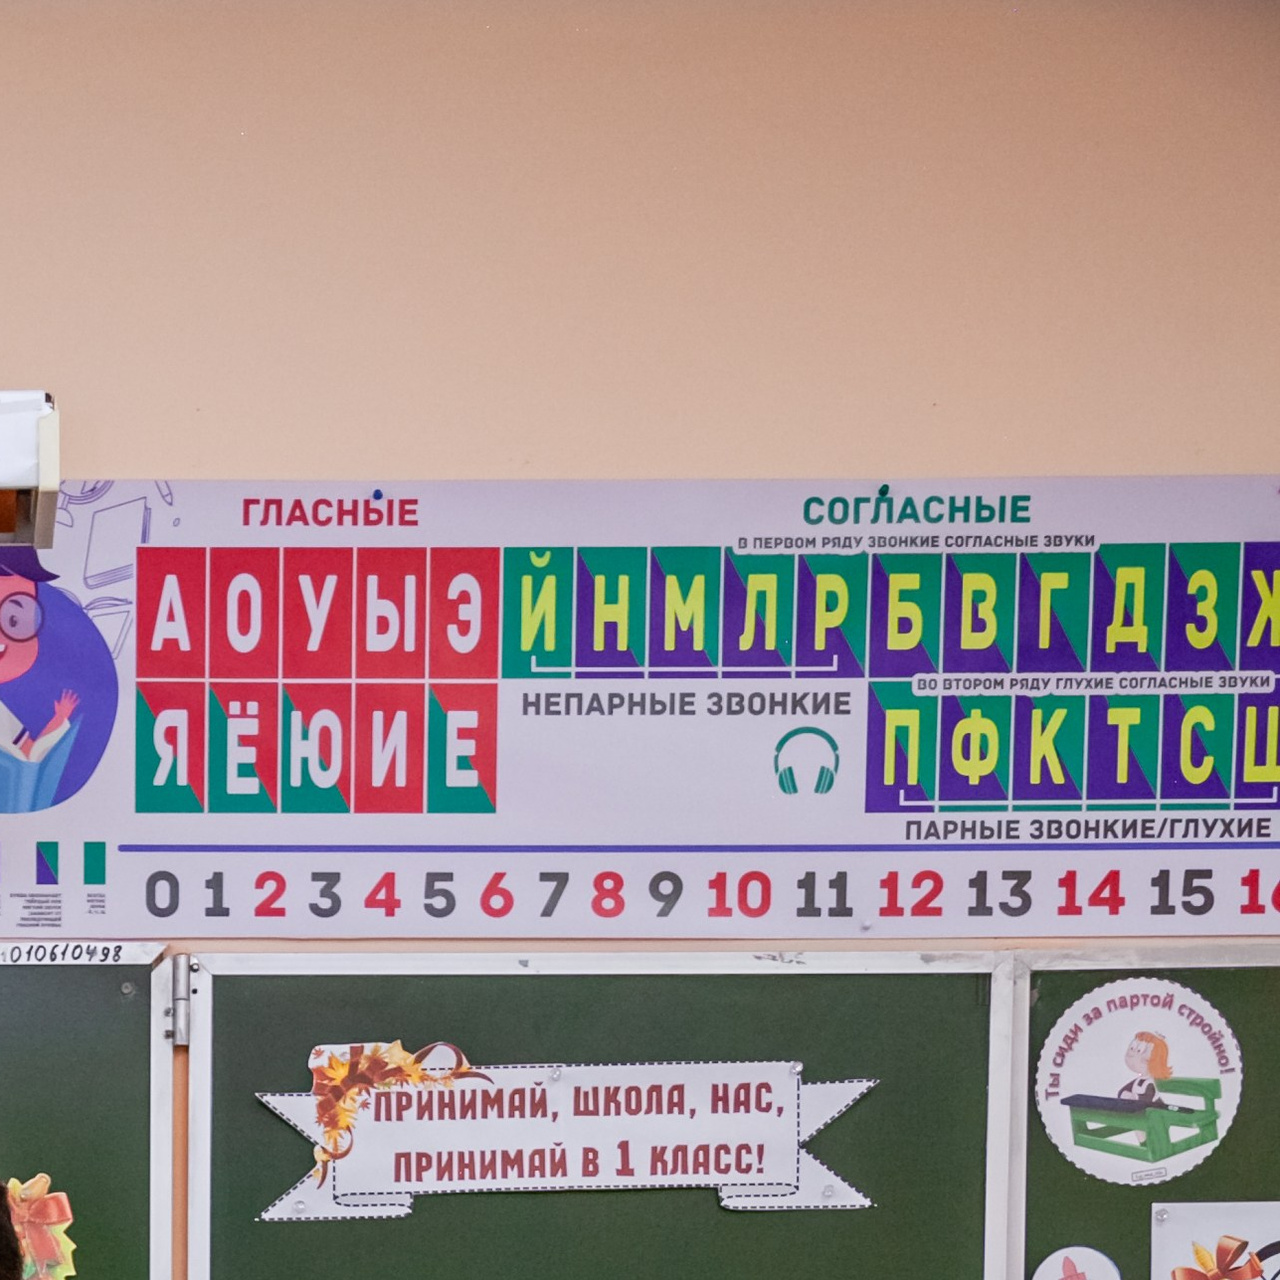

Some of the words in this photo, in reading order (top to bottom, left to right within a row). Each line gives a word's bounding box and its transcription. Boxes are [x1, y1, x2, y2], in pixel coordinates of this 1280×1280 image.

[242, 498, 419, 526] ГЛАСНЫЕ
[803, 495, 1032, 525] СОГЛАСНЫЕ
[738, 537, 748, 549] В
[753, 536, 817, 549] ПЕРВОМ
[821, 536, 863, 550] РЯДУ
[868, 535, 940, 548] ЗВОНКИЕ
[945, 534, 1040, 548] СОГЛАСНЫЕ
[1044, 534, 1095, 548] ЗВУКИ
[917, 678, 938, 691] ВО
[943, 678, 1005, 690] ВТОРОМ
[1009, 677, 1052, 692] РЯДУ
[1056, 677, 1115, 690] ГЛУХИЕ
[1119, 676, 1215, 689] СОГЛАСНЫЕ
[1218, 675, 1271, 689] ЗВУКИ
[521, 692, 696, 716] НЕПАРНЫЕ
[706, 692, 852, 715] ЗВОНКИЕ
[905, 819, 1021, 841] ПАРНЫЕ
[1029, 817, 1272, 840] ЗВОНКИЕ/ГЛУХИЕ
[145, 870, 180, 918] 0
[204, 871, 230, 917] 1
[253, 870, 287, 917] 2
[308, 870, 342, 918] 3
[364, 870, 401, 917] 4
[423, 871, 457, 918] 5
[479, 871, 514, 918] 6
[539, 871, 570, 917] 7
[590, 871, 626, 918] 8
[648, 871, 684, 918] 9
[707, 870, 773, 918] 10
[795, 870, 854, 917] 11
[879, 869, 945, 917] 12
[967, 869, 1033, 917] 13
[1056, 868, 1126, 916] 14
[1150, 868, 1215, 916] 15
[1082, 1006, 1103, 1026] за
[1106, 993, 1175, 1014] партой
[1052, 1023, 1084, 1068] сиди
[1177, 1003, 1236, 1075] стройно!
[1045, 1072, 1061, 1101] Ты
[373, 1081, 559, 1123] ПРИНИМАЙ,
[572, 1083, 697, 1120] ШКОЛА,
[709, 1081, 785, 1118] НАС,
[393, 1141, 569, 1183] ПРИНИМАЙ
[581, 1147, 600, 1177] В
[615, 1140, 635, 1177] 1
[649, 1141, 766, 1176] КЛАСС!
